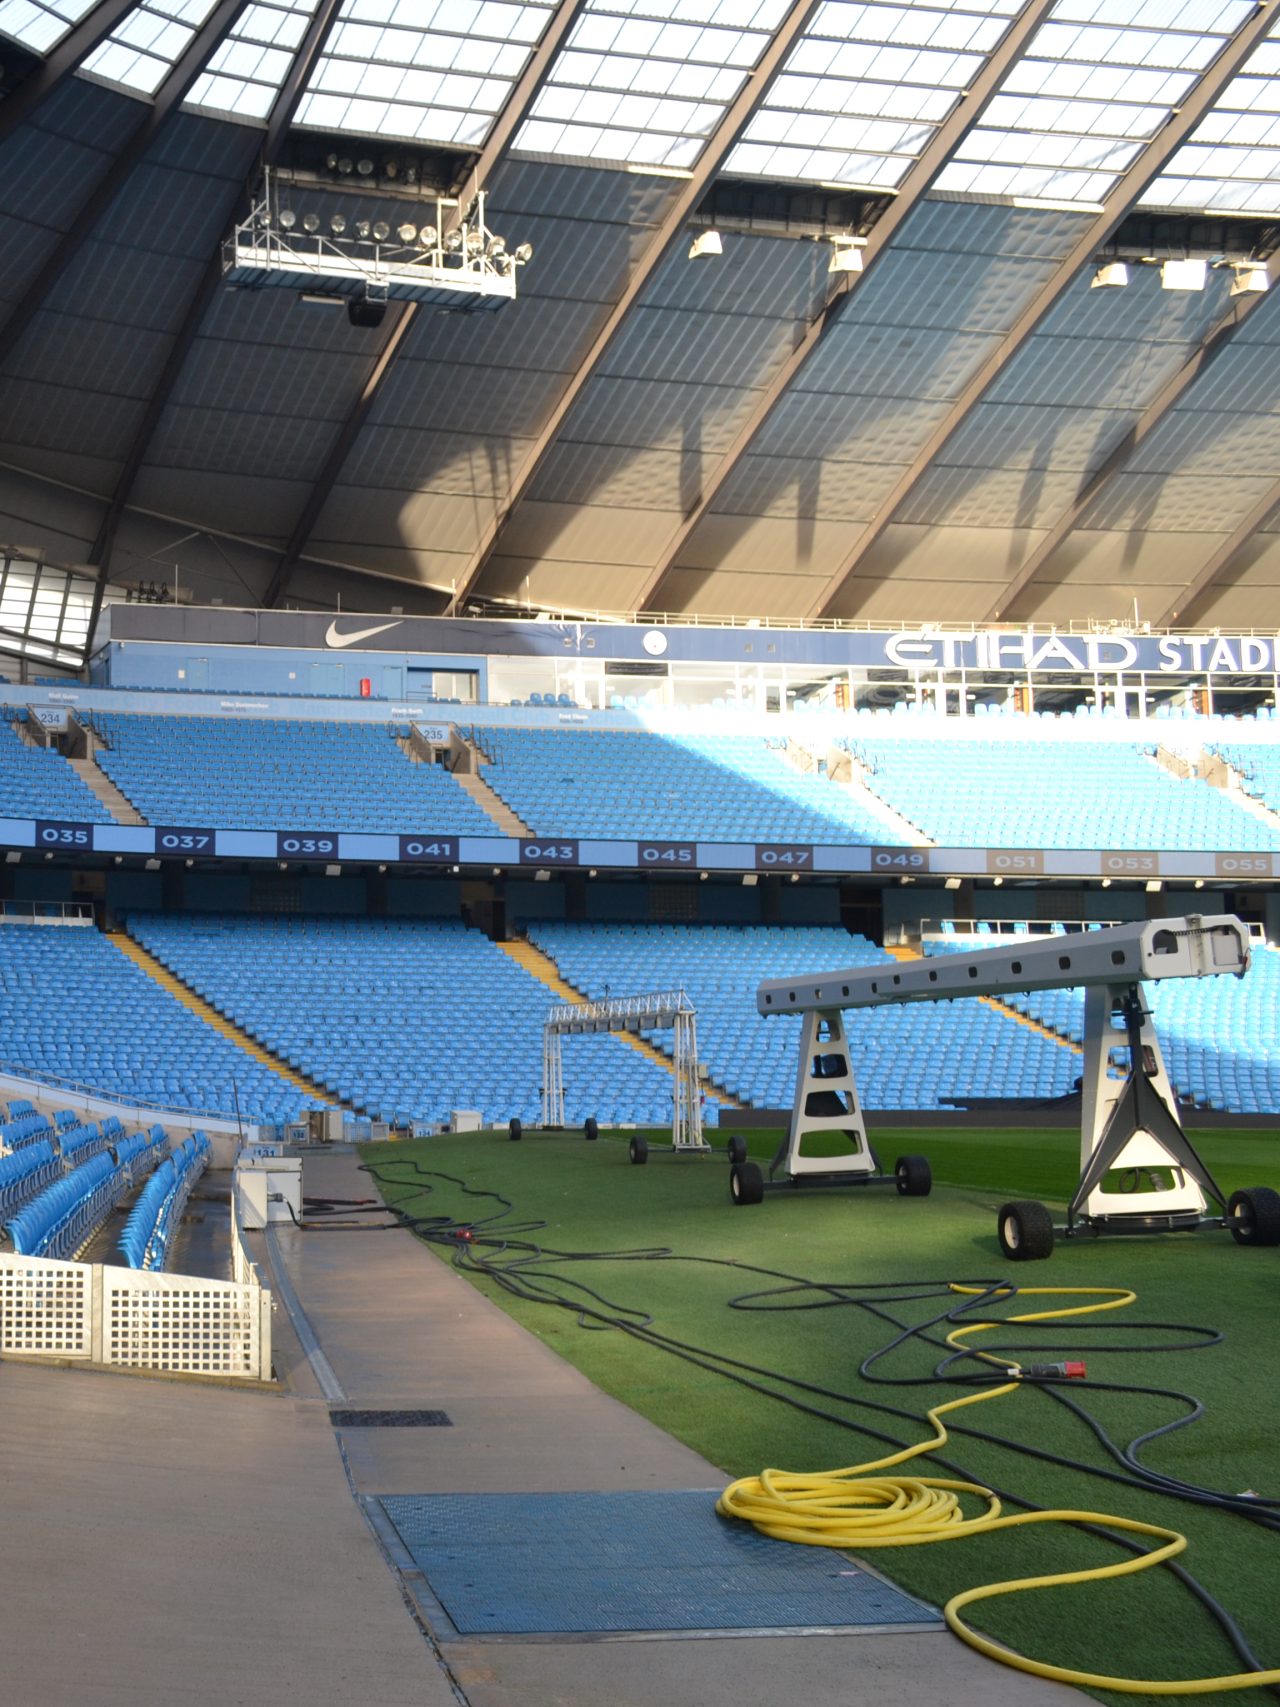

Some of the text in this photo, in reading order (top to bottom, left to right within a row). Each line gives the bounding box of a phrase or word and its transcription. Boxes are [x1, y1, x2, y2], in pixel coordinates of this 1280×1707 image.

[885, 631, 1139, 671] ETIHAD
[40, 713, 60, 724] 234
[424, 730, 443, 740] 235
